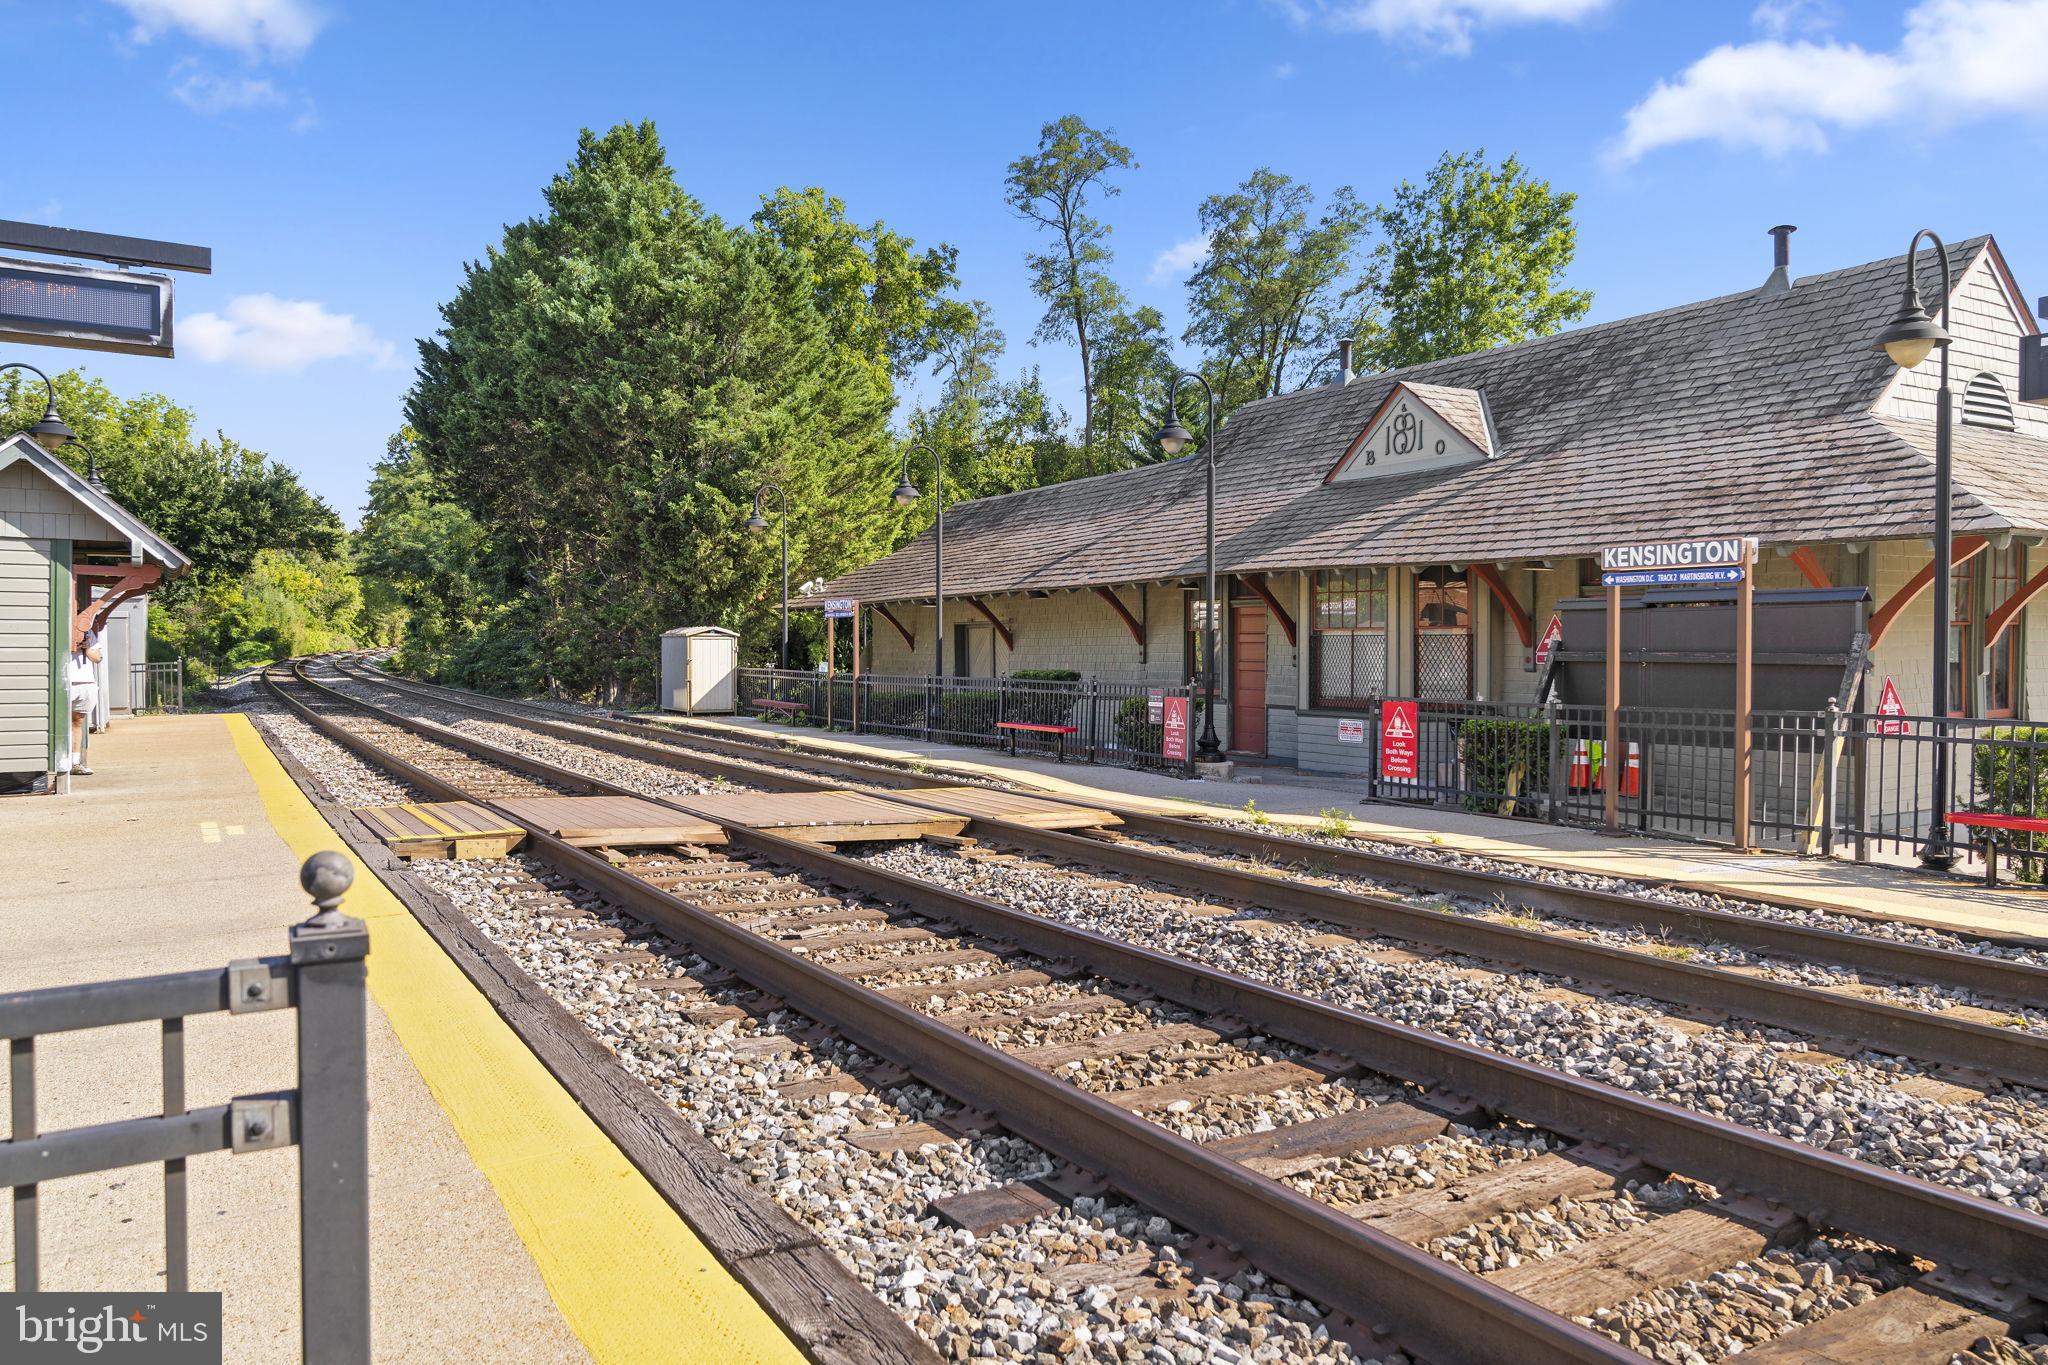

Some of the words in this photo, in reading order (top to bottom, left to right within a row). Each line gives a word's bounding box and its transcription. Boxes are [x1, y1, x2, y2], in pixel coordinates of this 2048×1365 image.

[1385, 412, 1423, 455] 1891
[1365, 450, 1376, 465] B
[1604, 540, 1739, 568] KENSINGTON
[1615, 575, 1645, 584] WASHINGTON
[1657, 574, 1672, 582] TRACK
[1679, 572, 1714, 581] MARTINSBURG
[1398, 749, 1413, 757] Ways
[1387, 764, 1411, 773] Crossing
